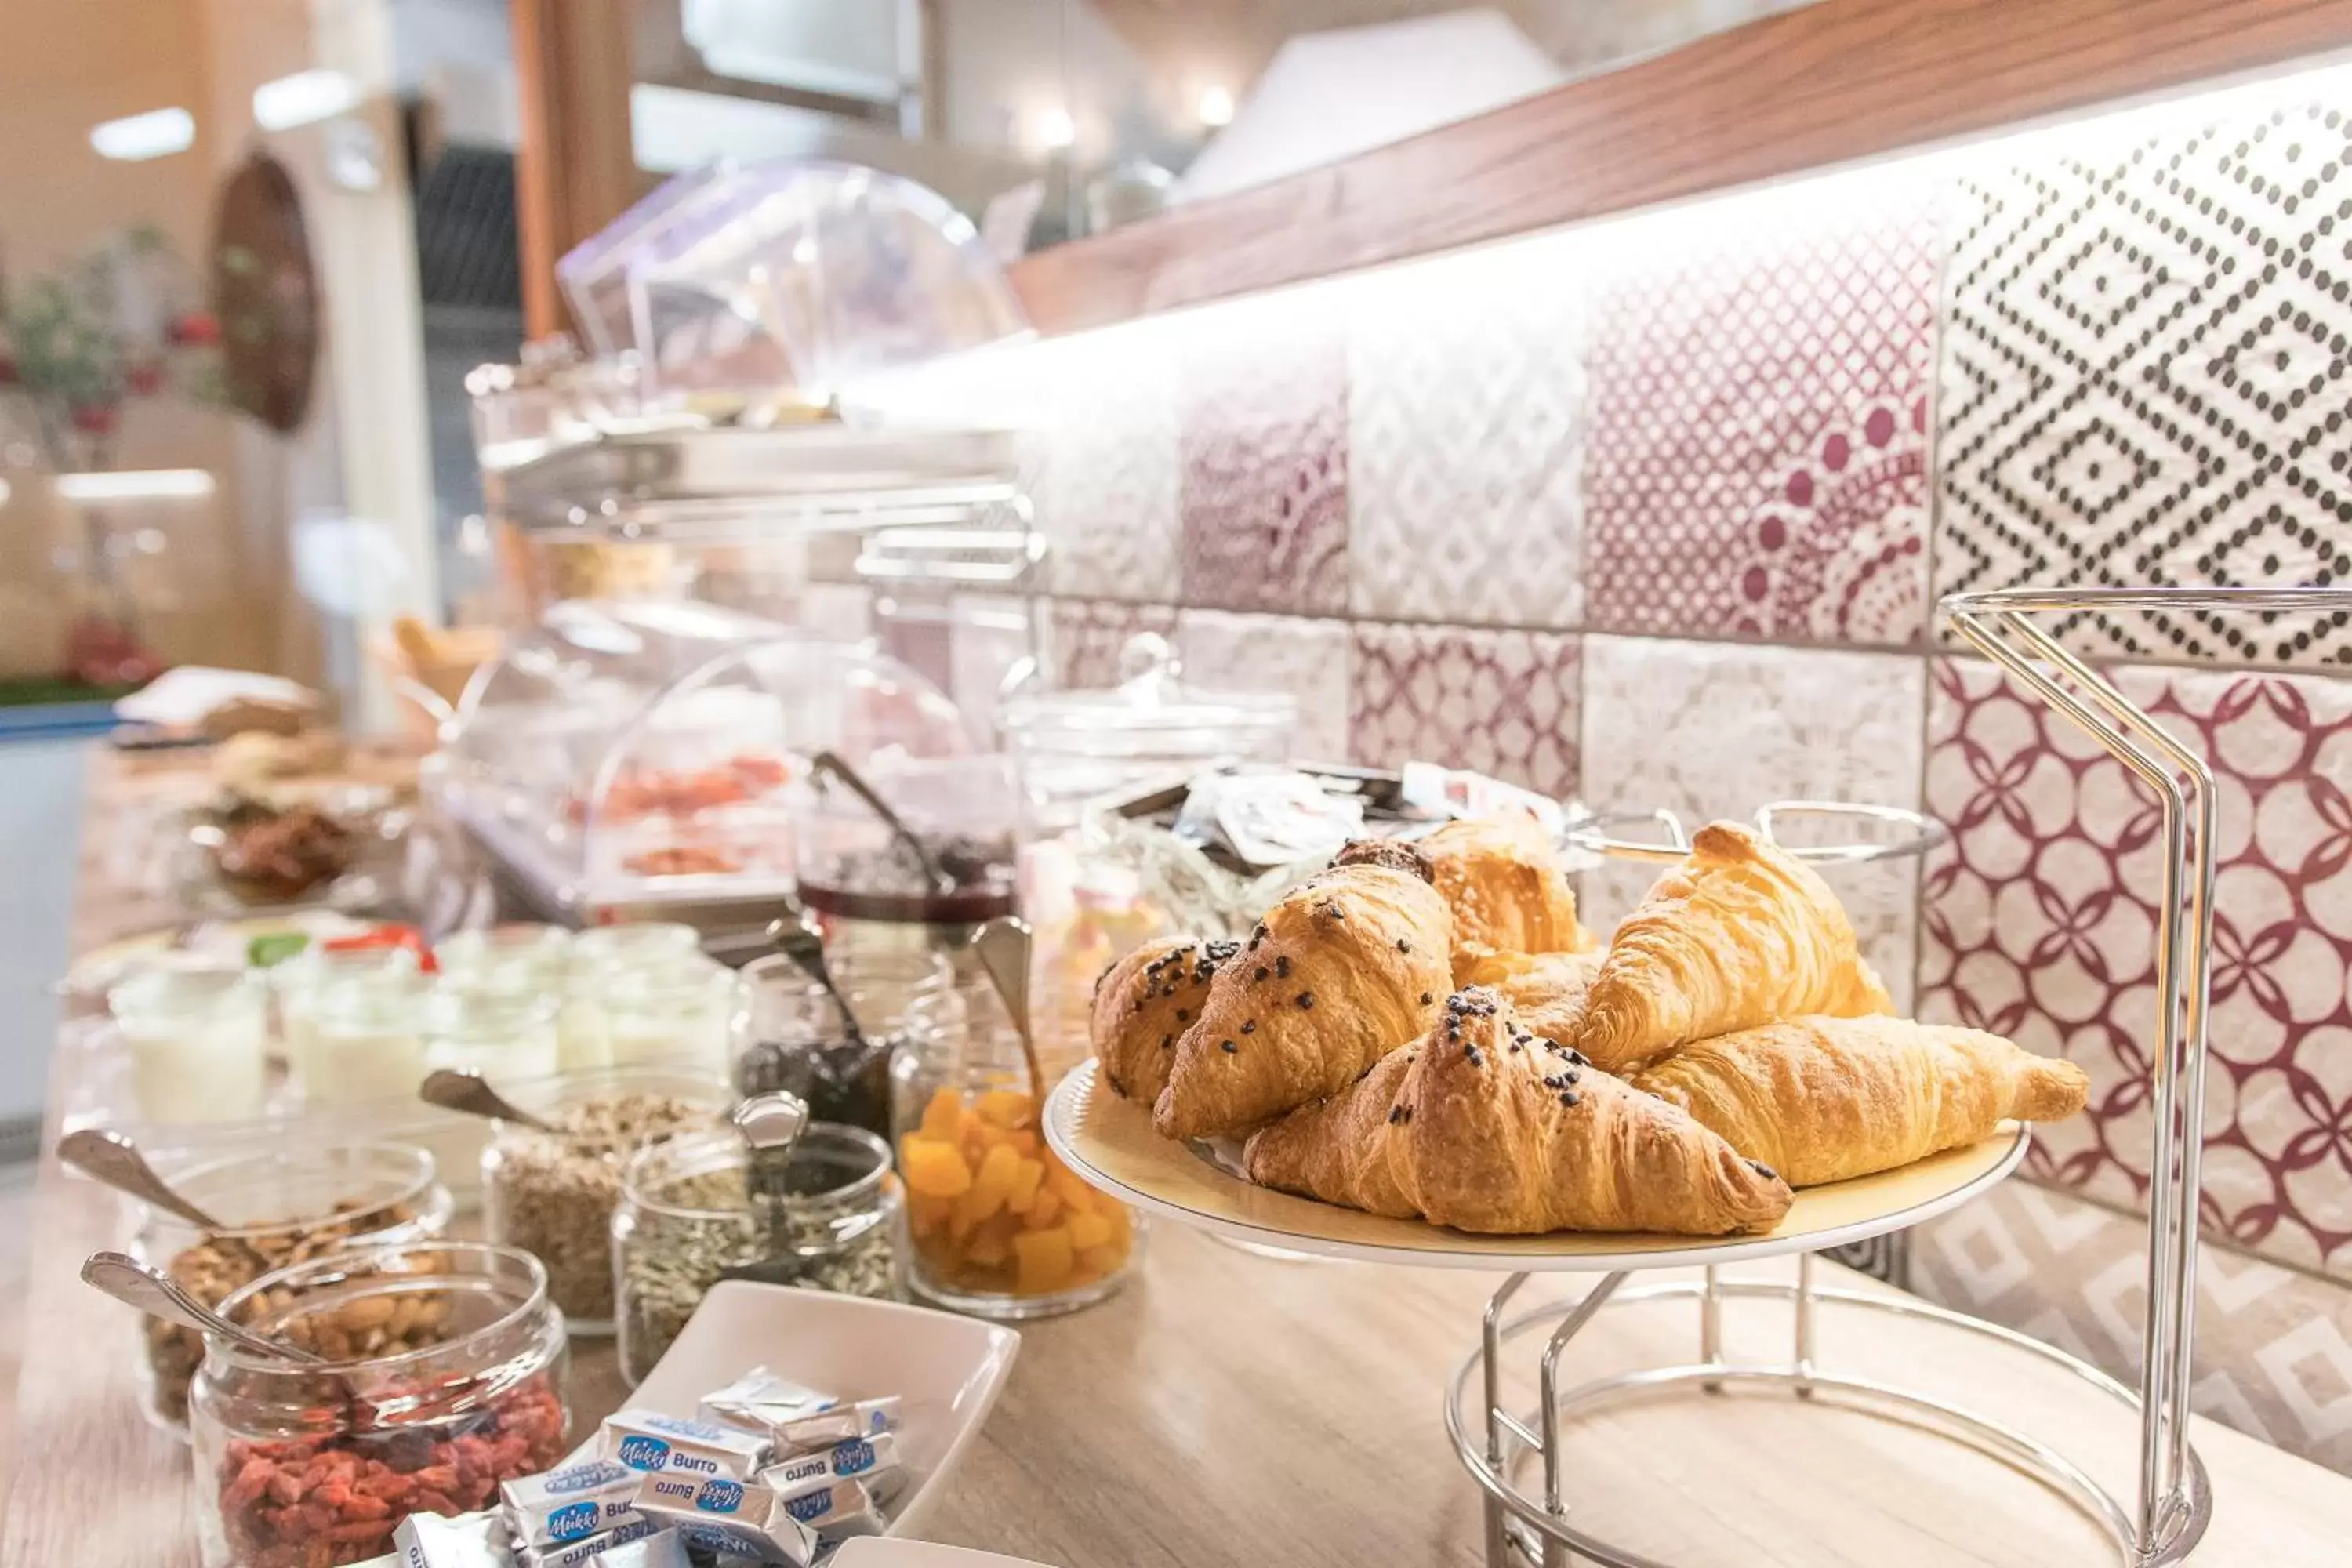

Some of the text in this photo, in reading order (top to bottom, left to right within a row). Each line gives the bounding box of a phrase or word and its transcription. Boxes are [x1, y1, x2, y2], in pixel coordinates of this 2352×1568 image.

[673, 1452, 718, 1475] Burro
[786, 1461, 827, 1482] Burro
[655, 1481, 695, 1500] Burro
[563, 1539, 606, 1564] Burro
